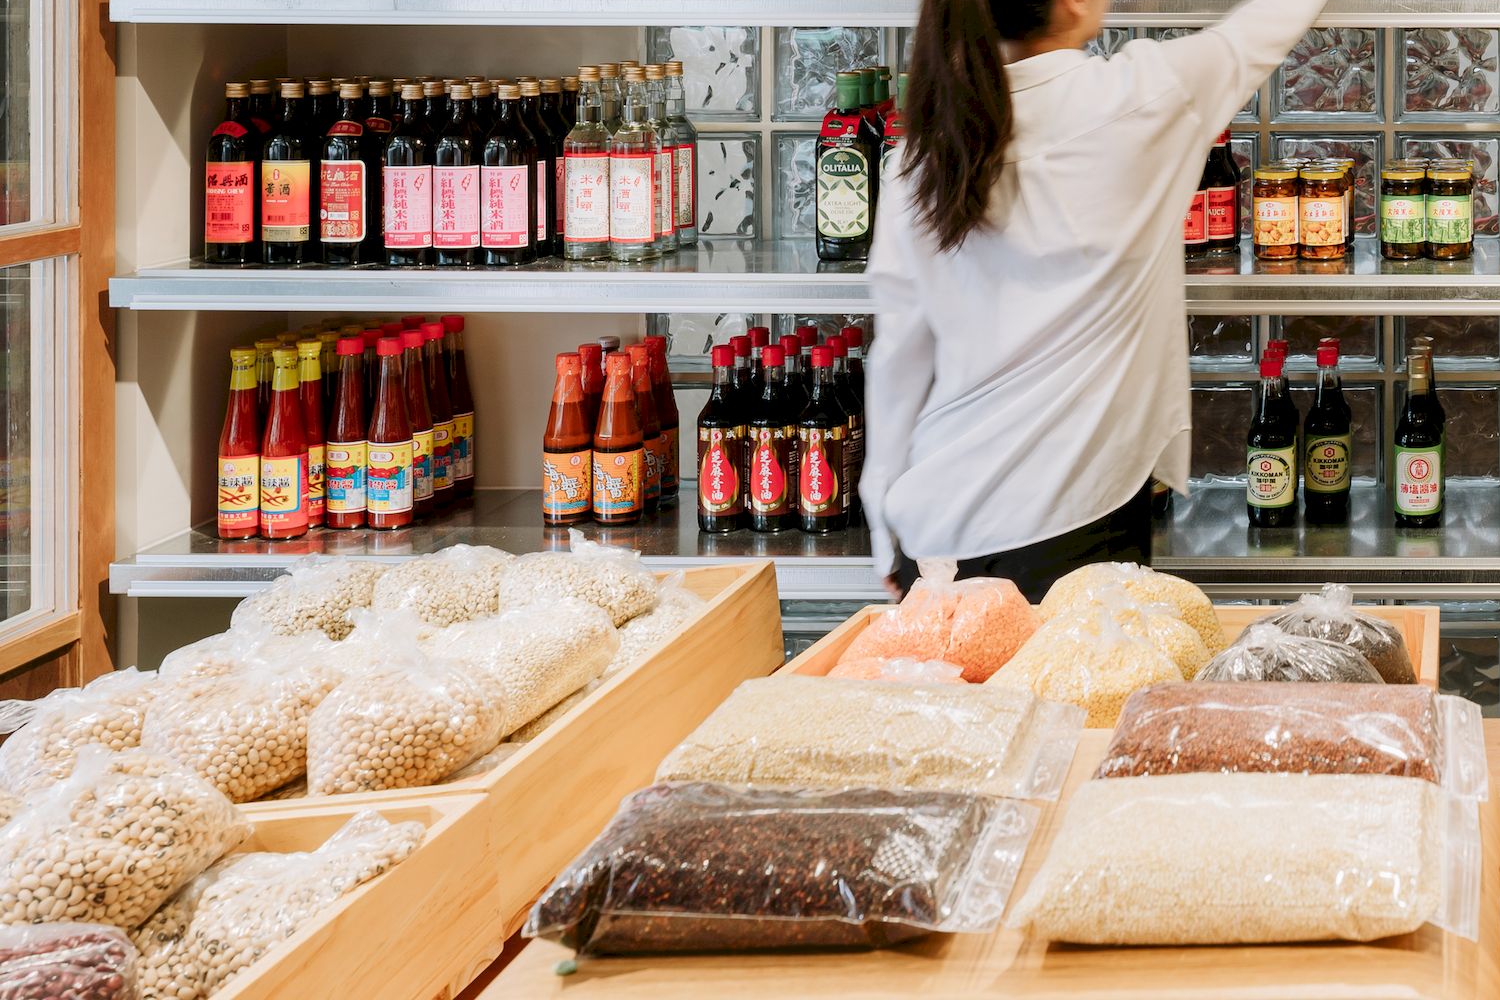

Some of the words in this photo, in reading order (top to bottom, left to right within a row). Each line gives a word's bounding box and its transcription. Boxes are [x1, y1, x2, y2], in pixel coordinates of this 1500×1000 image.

[265, 183, 291, 197] 黃酒
[822, 164, 862, 173] OLITALIA
[710, 449, 724, 501] 芝麻香油
[759, 449, 773, 501] 芝麻香油
[809, 449, 823, 501] 芝麻香油
